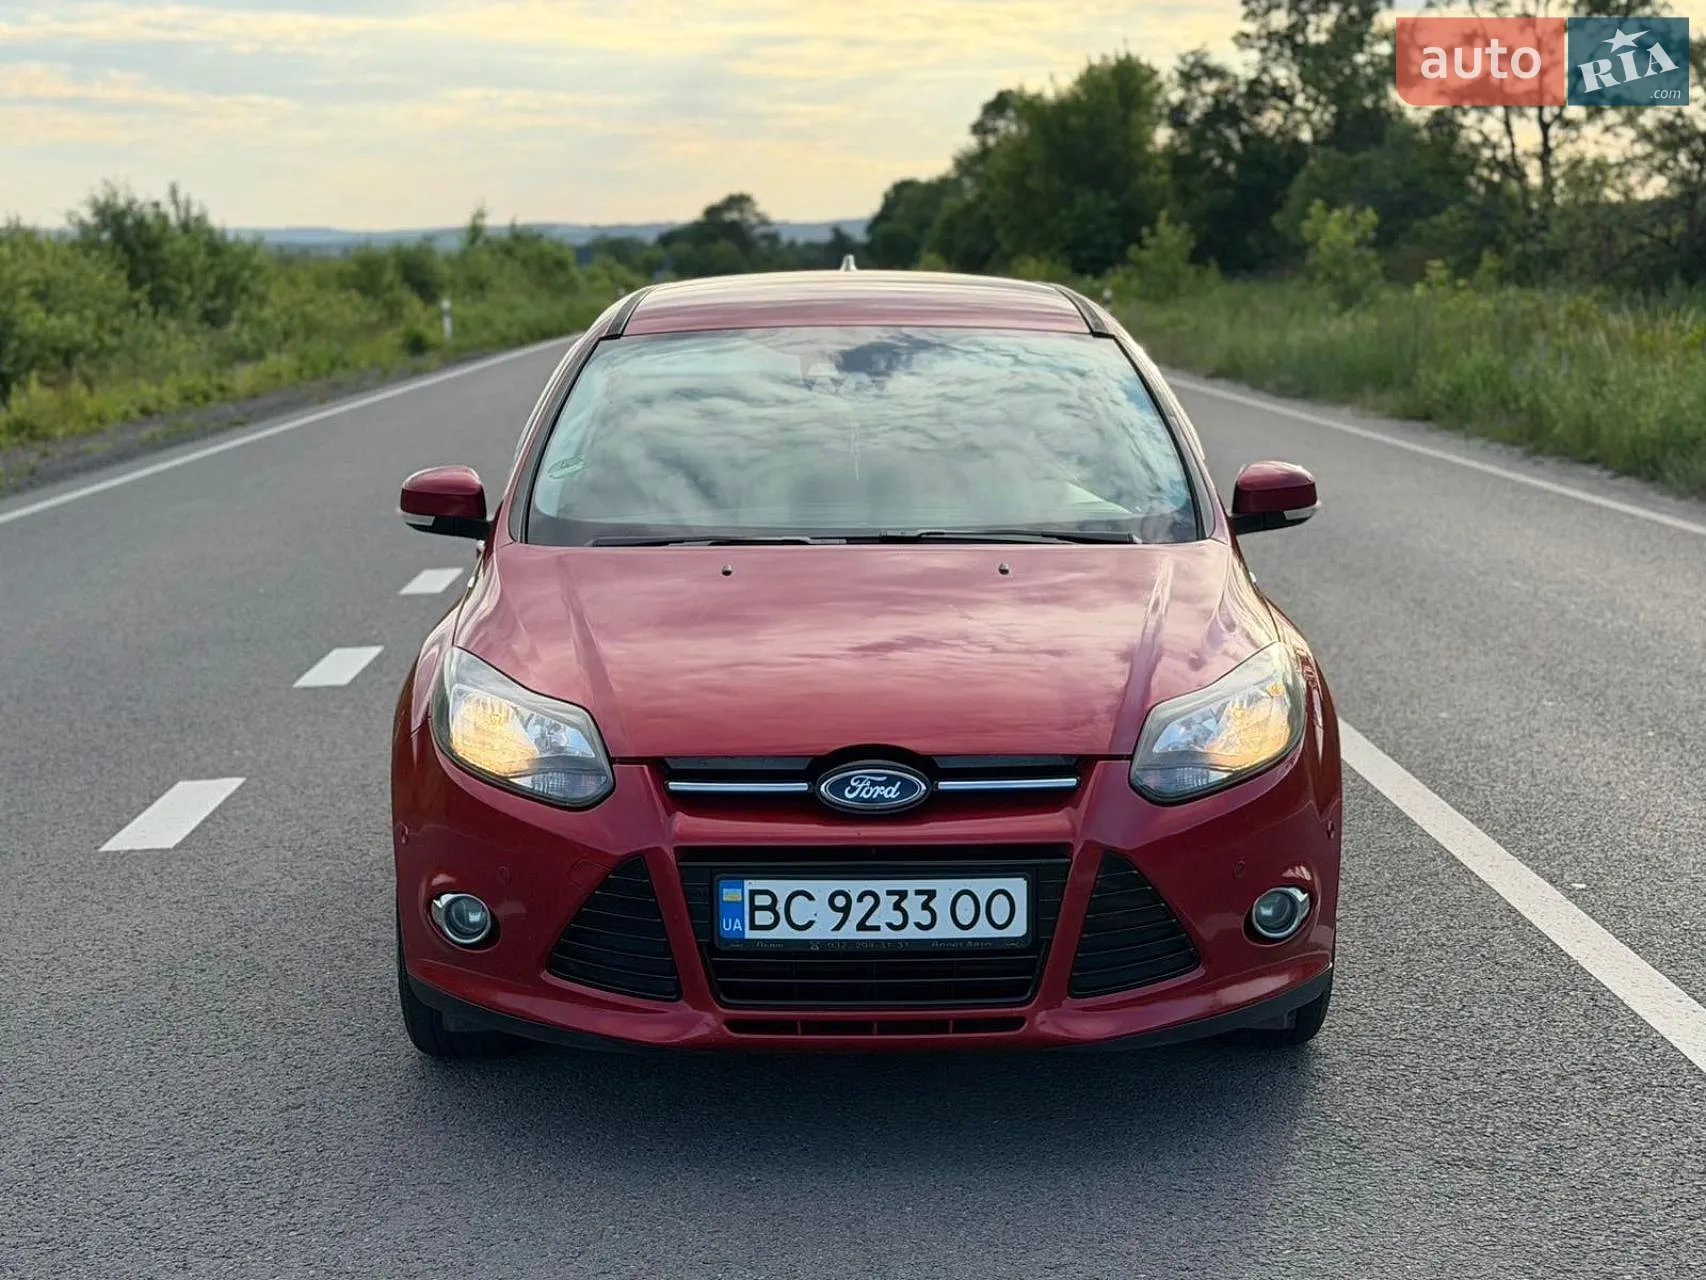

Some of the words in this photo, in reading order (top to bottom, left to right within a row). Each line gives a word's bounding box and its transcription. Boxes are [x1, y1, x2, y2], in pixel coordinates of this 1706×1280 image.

[844, 775, 901, 799] Ford
[748, 889, 816, 931] BC
[828, 889, 938, 932] 9233
[722, 917, 743, 932] UA
